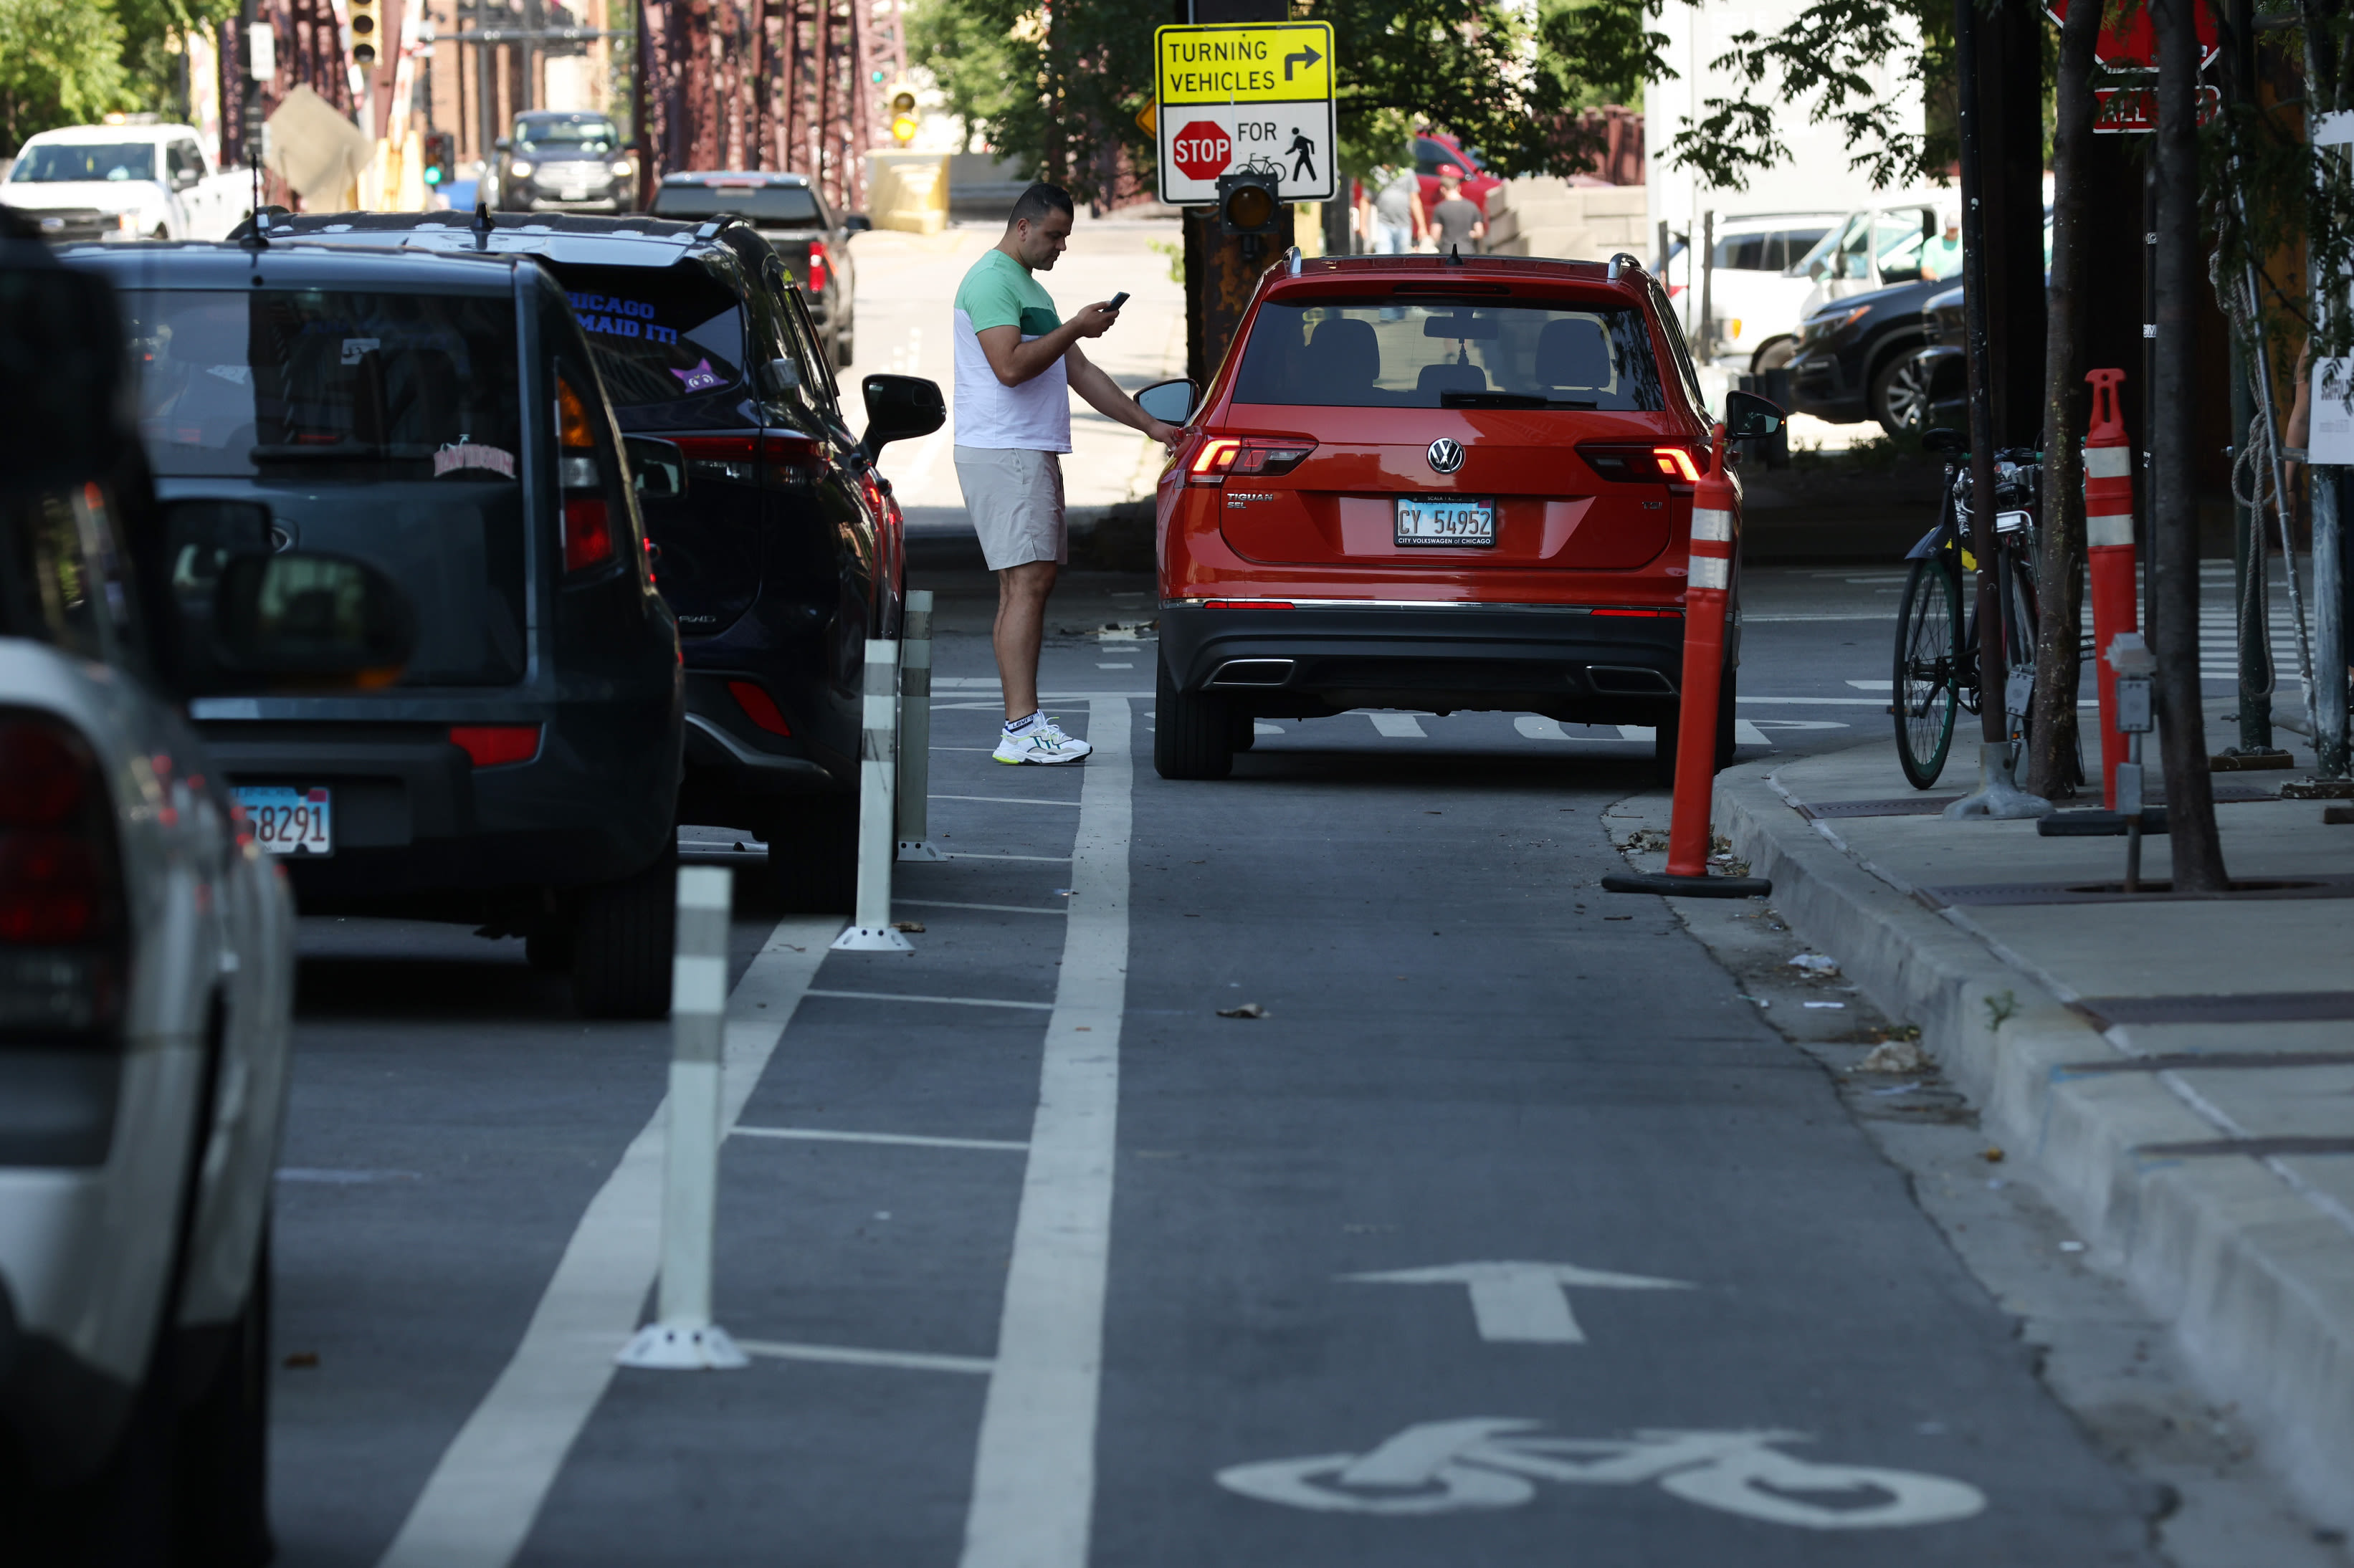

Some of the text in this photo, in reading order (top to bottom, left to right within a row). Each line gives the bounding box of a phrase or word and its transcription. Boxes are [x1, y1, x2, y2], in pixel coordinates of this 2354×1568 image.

[1169, 41, 1268, 62] TURNING
[1170, 71, 1275, 92] VEHICLES
[1238, 122, 1277, 142] FOR
[1176, 138, 1229, 163] STOP
[565, 290, 655, 320] HICAGO
[575, 312, 677, 345] MAID IT!
[1399, 510, 1490, 535] CY 54952
